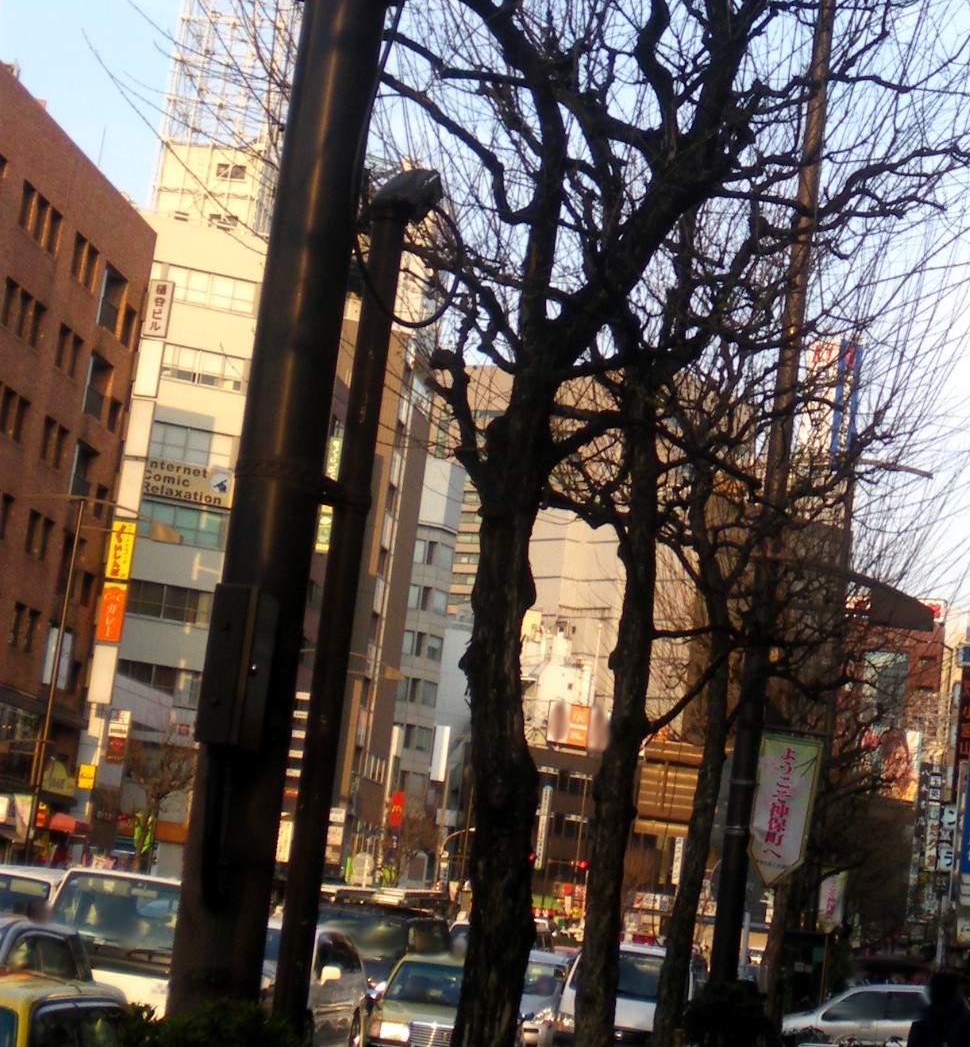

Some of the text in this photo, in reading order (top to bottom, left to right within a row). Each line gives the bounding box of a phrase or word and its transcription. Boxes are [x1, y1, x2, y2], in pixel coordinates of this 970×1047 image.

[762, 747, 796, 860] ようこそ神保町へ
